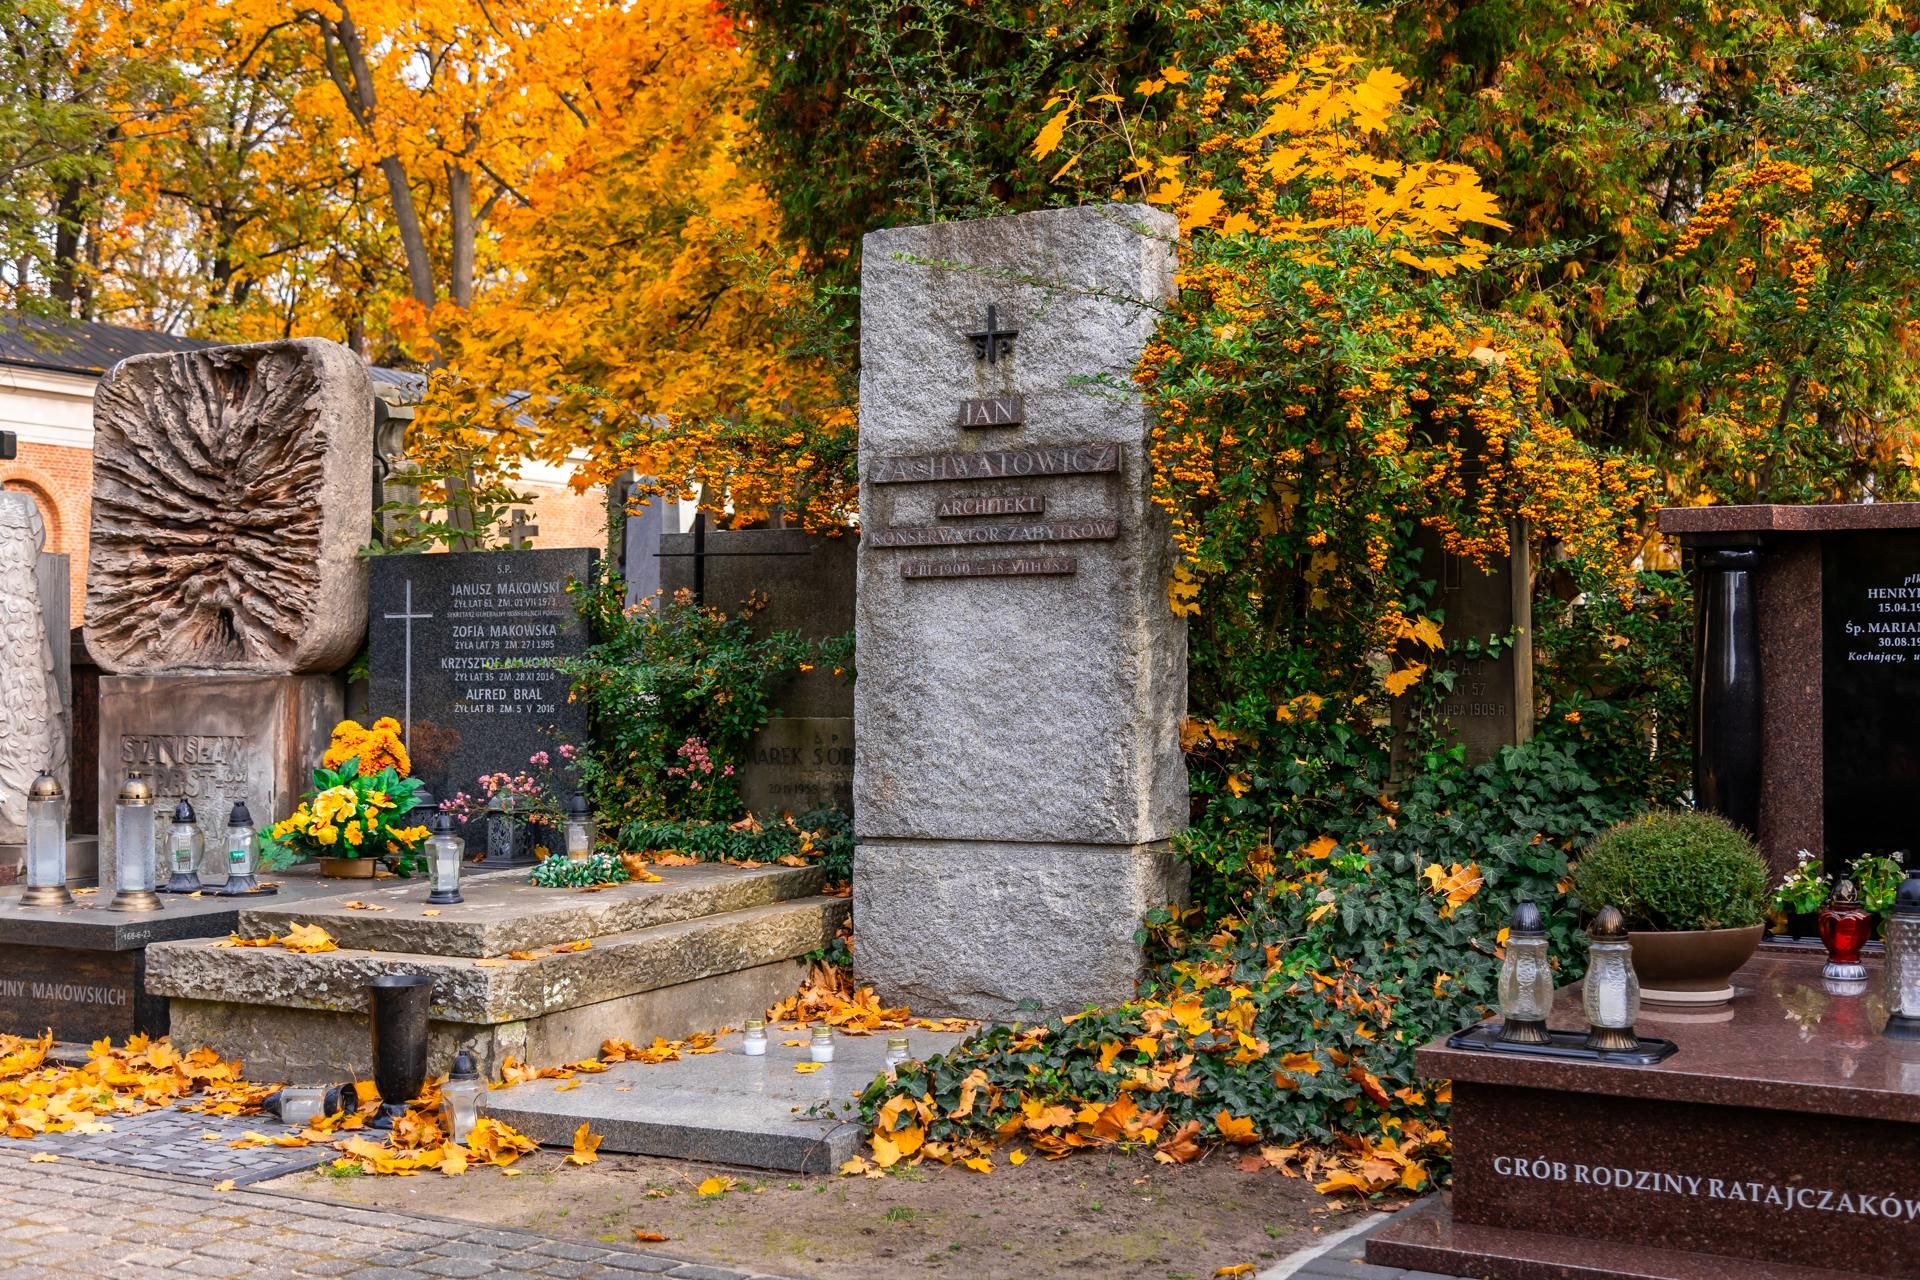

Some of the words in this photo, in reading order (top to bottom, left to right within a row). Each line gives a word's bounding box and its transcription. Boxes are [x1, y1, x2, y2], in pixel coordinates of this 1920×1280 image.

[963, 399, 1013, 425] JAN
[940, 496, 1041, 516] ARCHITEKT
[872, 526, 999, 546] KONSERWATOR
[450, 583, 492, 596] JANUSZ
[497, 580, 560, 595] MAKOWSKI
[452, 625, 485, 638] ZOFIA
[490, 624, 557, 637] MAKOWSKA
[1845, 620, 1866, 637] Śp.
[476, 641, 490, 650] LAT
[491, 641, 500, 649] 79
[504, 641, 520, 649] ZM.
[521, 640, 531, 649] 27
[536, 640, 555, 649] 1995
[1847, 651, 1906, 664] Kochający,
[484, 673, 494, 681] 35
[499, 672, 514, 681] ZM.
[515, 672, 525, 681] 28
[536, 672, 555, 681] 2014
[465, 688, 507, 700] ALFRED
[513, 688, 543, 700] BRAL
[486, 704, 495, 713] 81
[516, 704, 522, 713] 5
[526, 704, 533, 713] V
[536, 704, 555, 713] 2016
[121, 736, 248, 768] STANISŁAW
[32, 981, 126, 1006] MAKOWSKICH
[1494, 1154, 1568, 1181] GRÓB
[1574, 1163, 1702, 1196] RODZINY
